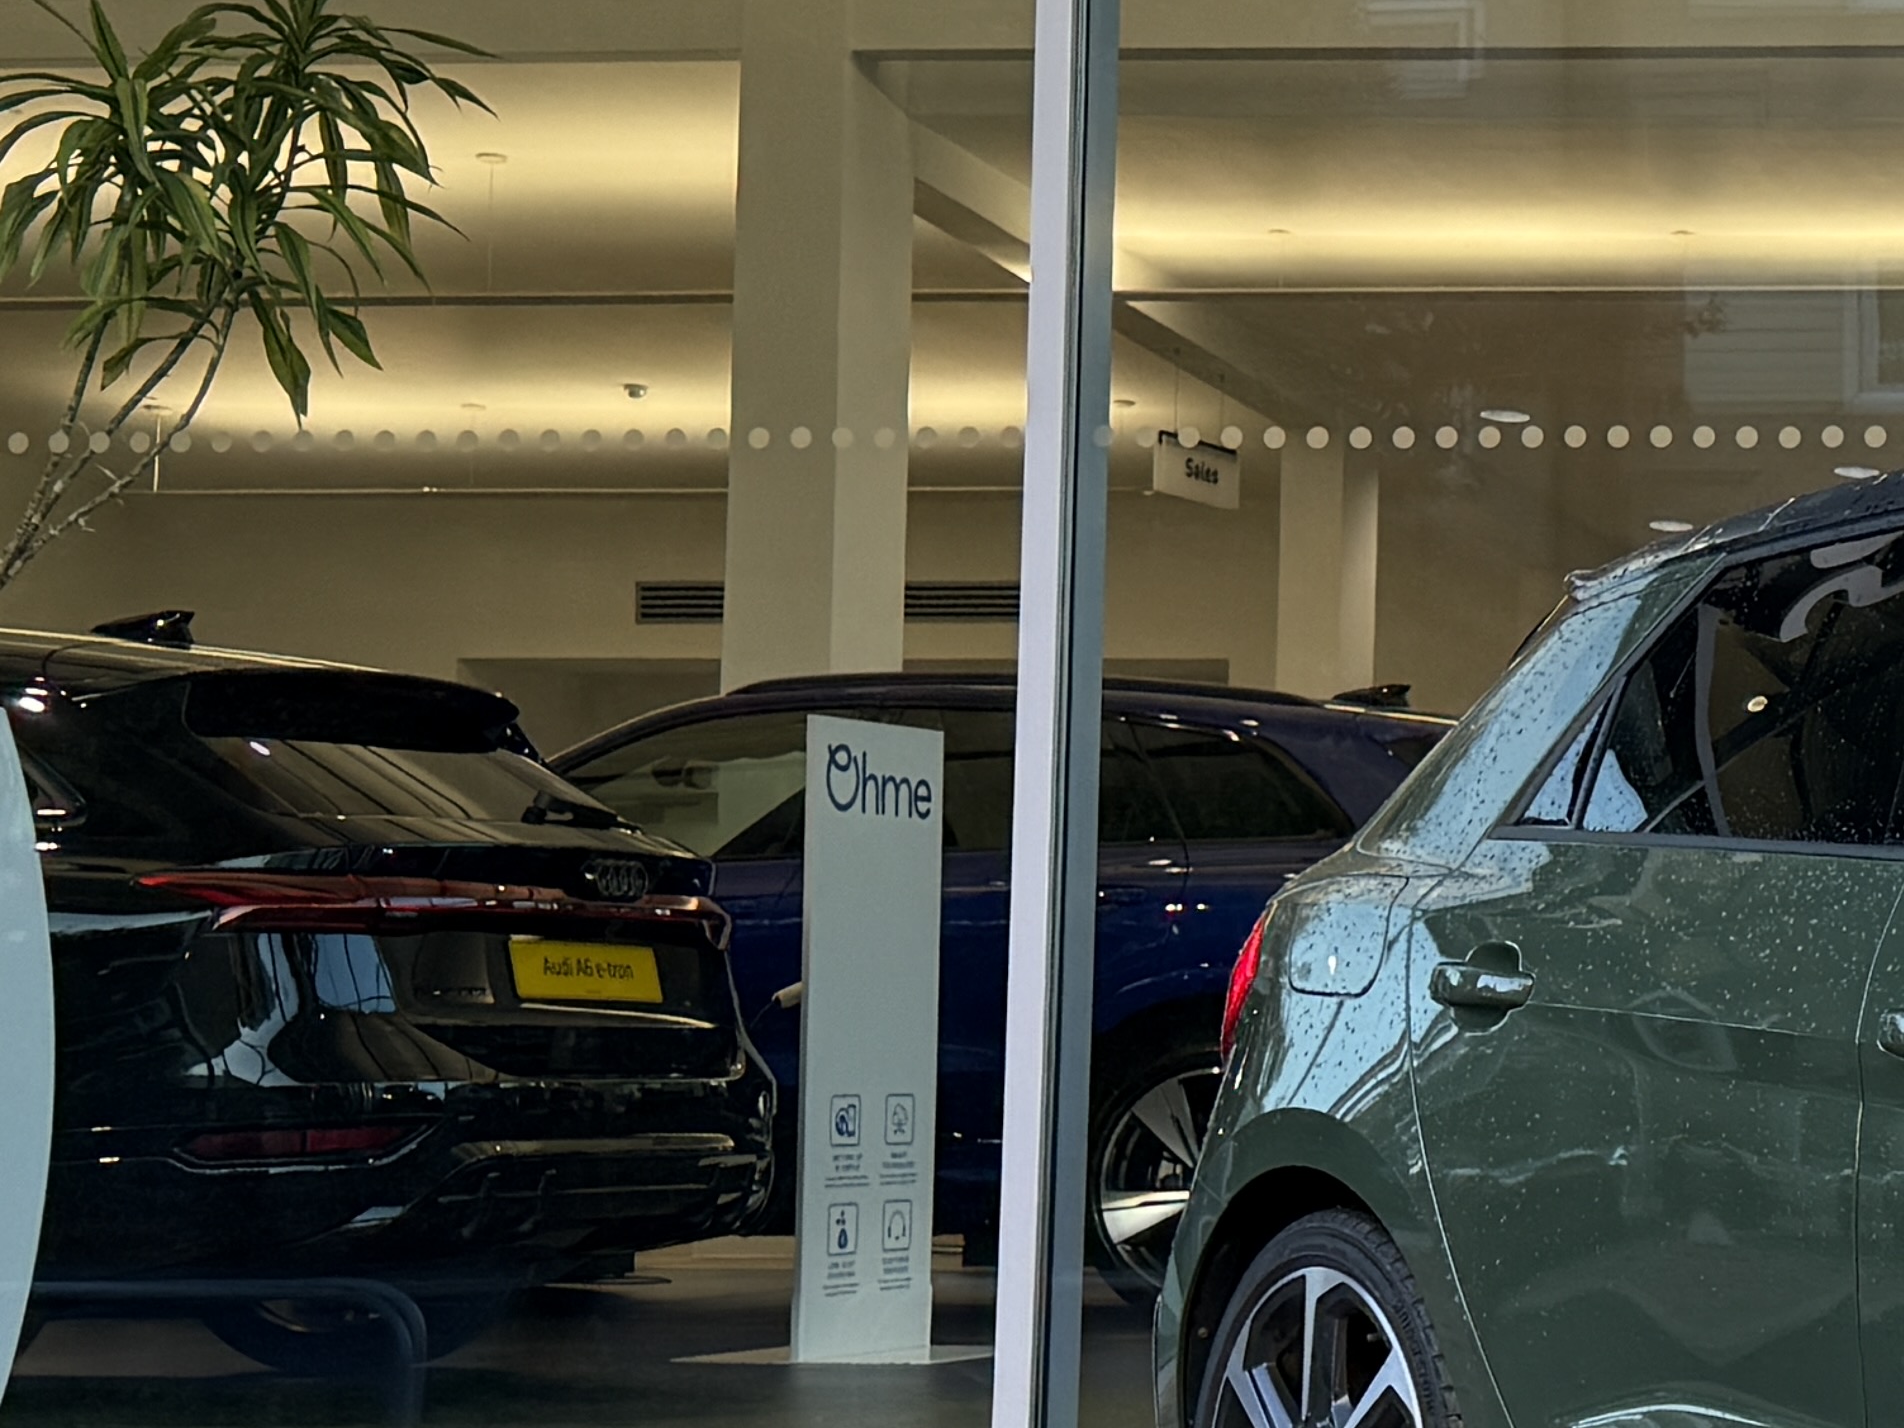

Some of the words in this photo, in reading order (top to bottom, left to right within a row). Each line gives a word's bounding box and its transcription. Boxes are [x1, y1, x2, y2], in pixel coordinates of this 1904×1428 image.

[1185, 456, 1219, 485] Sales
[826, 743, 932, 820] Ohme
[543, 956, 574, 977] Audi
